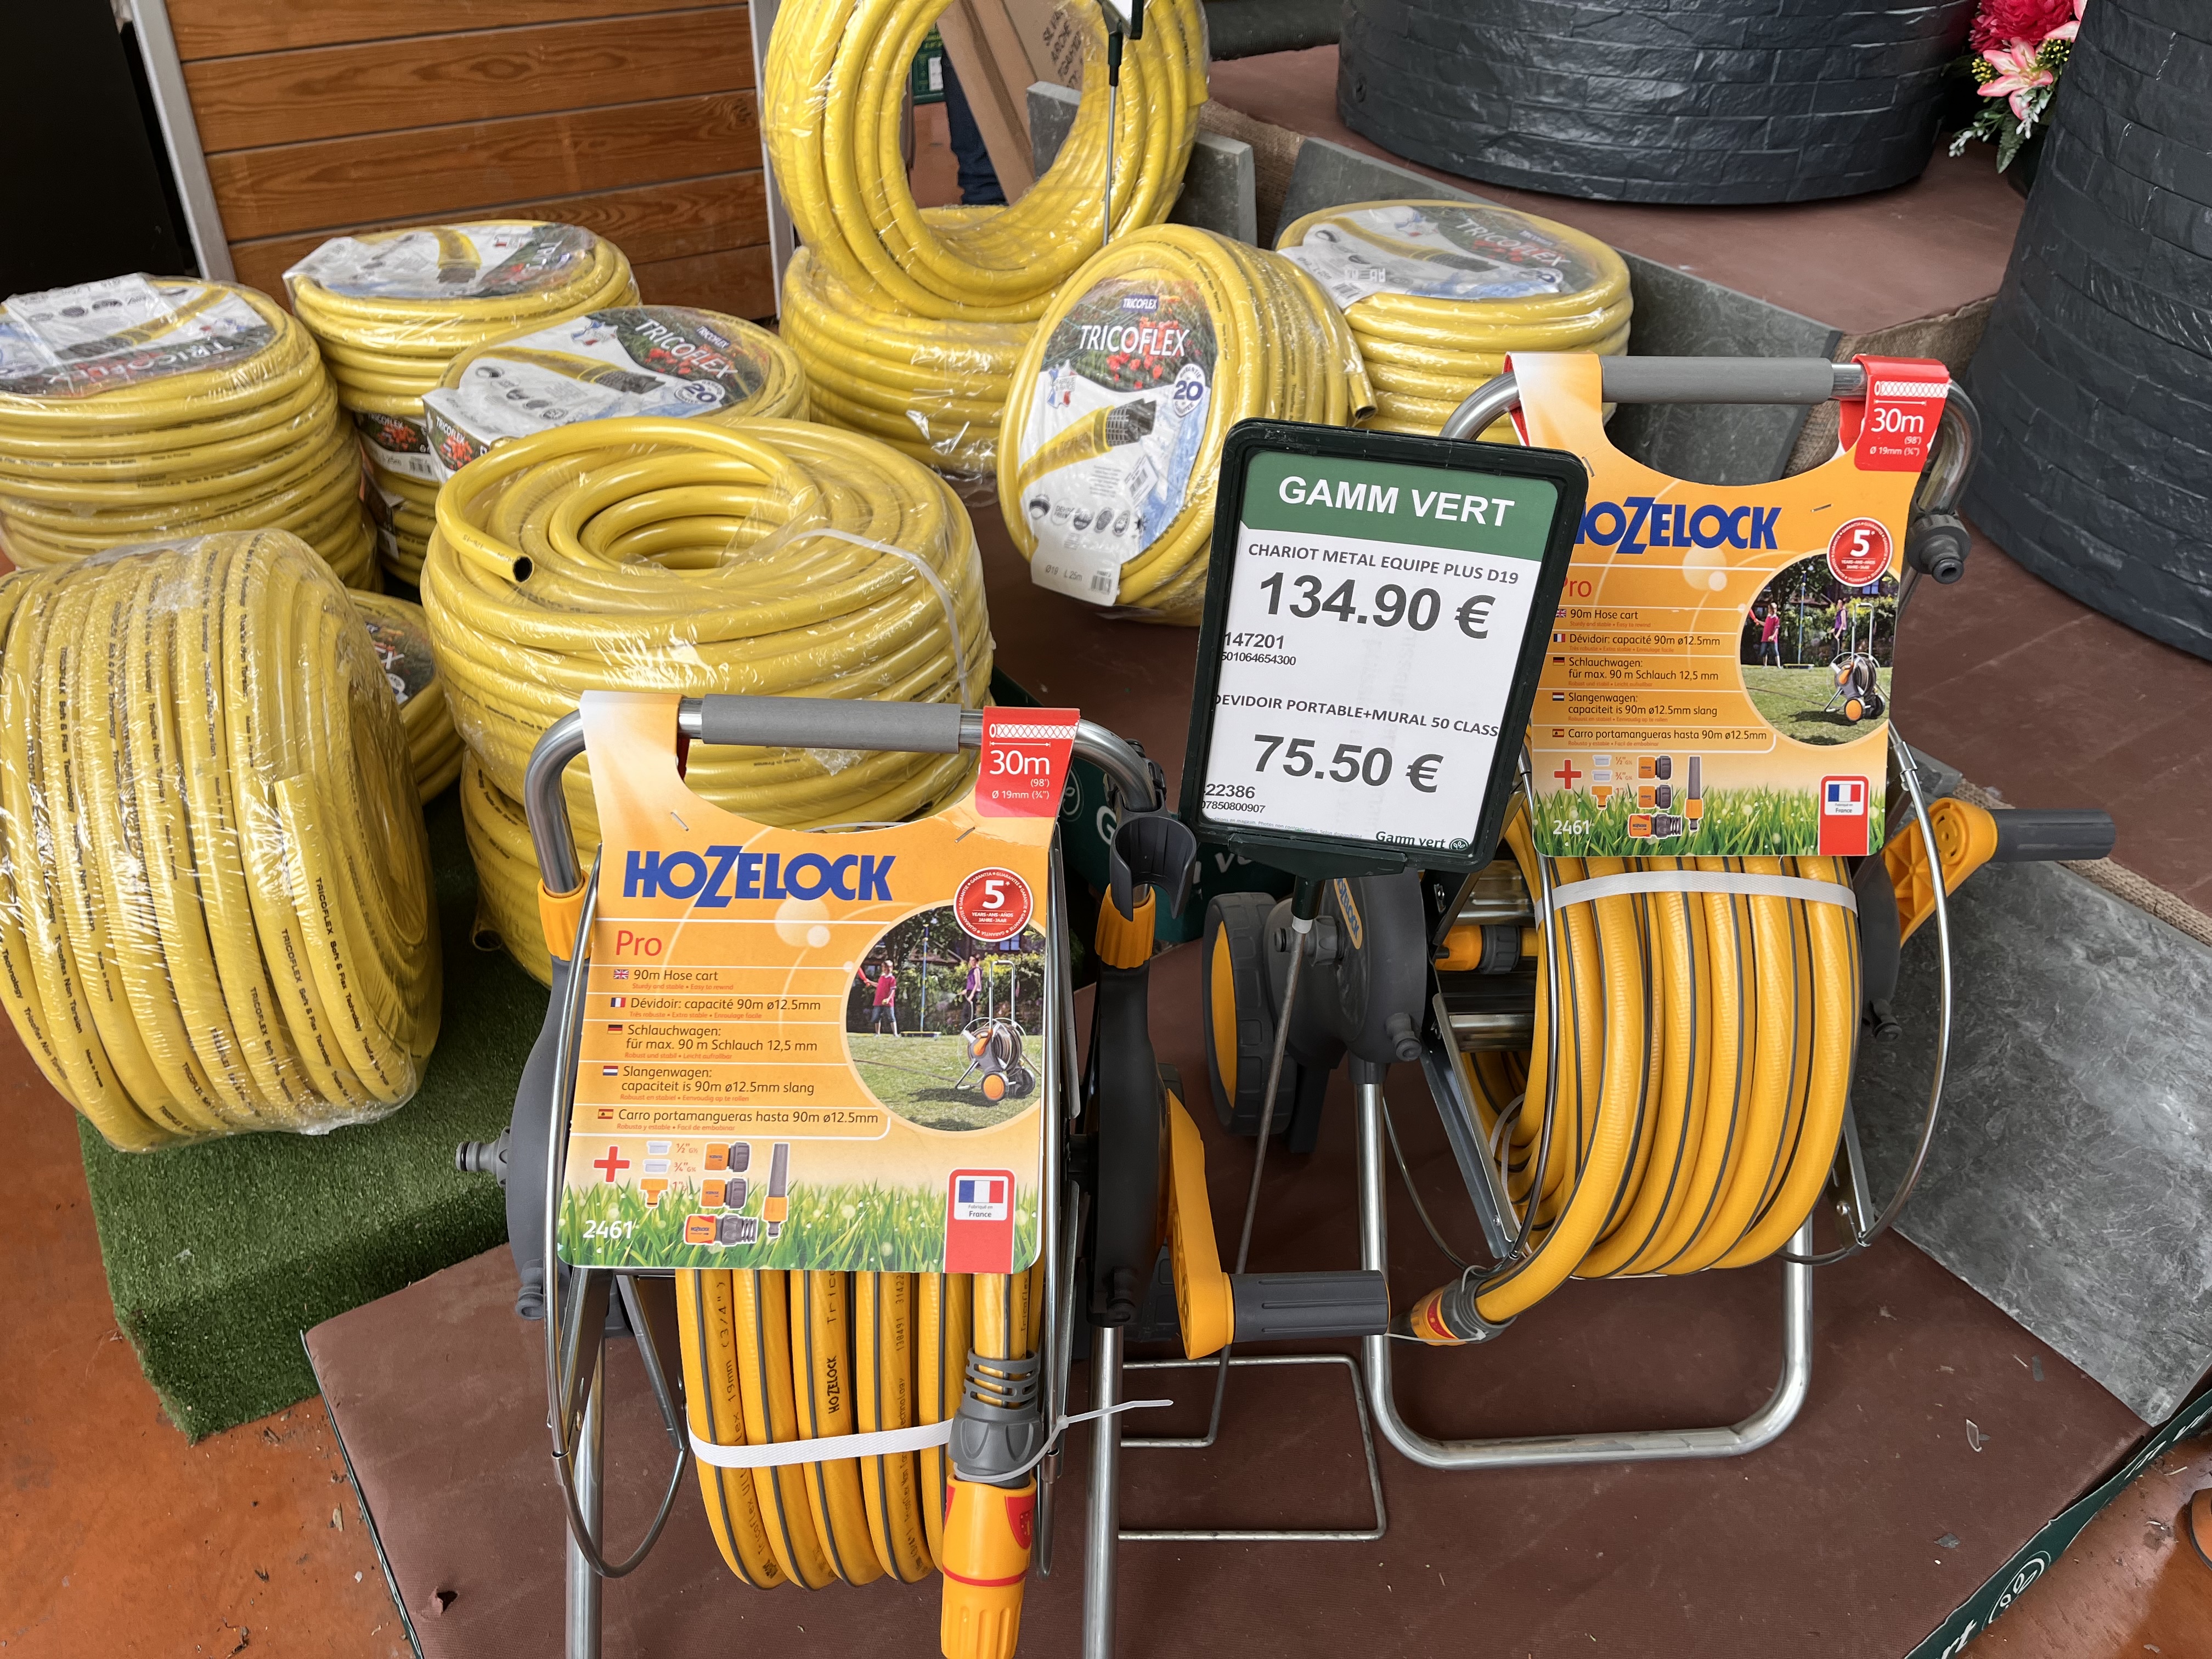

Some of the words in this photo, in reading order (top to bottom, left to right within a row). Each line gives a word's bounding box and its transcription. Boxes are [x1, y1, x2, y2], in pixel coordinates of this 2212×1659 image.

[1455, 218, 1572, 267] TRICOFLEX
[1123, 298, 1157, 309] TRICOFLEX
[635, 318, 738, 379] TRICOFLEX
[1079, 325, 1190, 357] TRICOFLEX
[1173, 380, 1204, 401] 20
[1871, 408, 1924, 433] 30m
[436, 416, 465, 445] TRICOFLEX
[1878, 447, 1902, 455] 19mm
[1279, 476, 1399, 515] GAMM
[1412, 489, 1515, 527] VERT
[1249, 544, 1319, 561] CHARIOT
[1323, 550, 1376, 567] METAL
[1381, 556, 1439, 574] EQUIPE
[1443, 563, 1482, 580] PLUS
[1487, 569, 1519, 584] D19
[1261, 572, 1441, 631] 134.90
[1454, 595, 1496, 639] €
[1570, 609, 1592, 618] 90m
[1595, 610, 1617, 619] Hose
[1620, 611, 1638, 619] cart
[1570, 633, 1610, 643] Dévidoir:
[1613, 634, 1651, 646] capacité
[1654, 635, 1675, 645] 90m
[1569, 657, 1643, 670] Schlauchwagen:
[1568, 669, 1582, 679] für
[1584, 671, 1607, 679] max.
[1610, 670, 1622, 679] 90
[1636, 670, 1677, 680] Schlauch
[1680, 671, 1698, 681] 12,5
[1568, 692, 1638, 704] Slangenwagen:
[1287, 699, 1427, 727] PORTABLE+MURAL
[1431, 716, 1449, 729] 50
[1453, 720, 1499, 737] CLASS
[1568, 706, 1613, 715] capaciteit
[1616, 706, 1622, 714] is
[1625, 706, 1646, 715] 90m
[1694, 707, 1718, 717] slang
[1568, 729, 1593, 738] Carro
[1596, 730, 1671, 741] portamangueras
[1674, 730, 1699, 739] hasta
[1702, 730, 1723, 740] 90m
[989, 750, 1049, 775] 30m
[1254, 734, 1392, 786] 75.50
[1406, 754, 1444, 793] €
[1002, 791, 1029, 799] 19mm
[1553, 820, 1591, 835] 2461
[1375, 831, 1415, 847] Gamm
[1419, 836, 1446, 849] vert
[623, 845, 896, 907] HOZELOCK
[315, 877, 334, 936] TRICOFLEX
[616, 930, 662, 956] Pro
[281, 928, 303, 983] TRICOFLEX
[634, 970, 660, 980] 90m
[664, 970, 692, 980] Hose
[696, 971, 719, 981] cart
[630, 997, 681, 1009] Dévidoir:
[684, 998, 733, 1011] capacité
[737, 999, 763, 1009] 90m
[627, 1025, 721, 1039] Schlauchwagen:
[625, 1038, 643, 1049] für
[646, 1040, 674, 1049] max.
[678, 1039, 693, 1049] 90
[696, 1041, 708, 1049] m
[712, 1040, 763, 1051] Schlauch
[768, 1040, 791, 1052] 12,5
[794, 1042, 817, 1052] mm
[623, 1066, 712, 1080] Slangenwagen:
[621, 1081, 679, 1094] capaciteit
[682, 1081, 691, 1092] is
[695, 1082, 721, 1092] 90m
[783, 1082, 815, 1096] slang
[618, 1109, 651, 1121] Carro
[653, 1110, 753, 1125] portamangueras
[756, 1111, 789, 1122] hasta
[793, 1111, 820, 1123] 90m
[583, 1220, 633, 1239] 2461
[726, 1360, 736, 1402] 19mm
[827, 1356, 839, 1414] HOZELOCK
